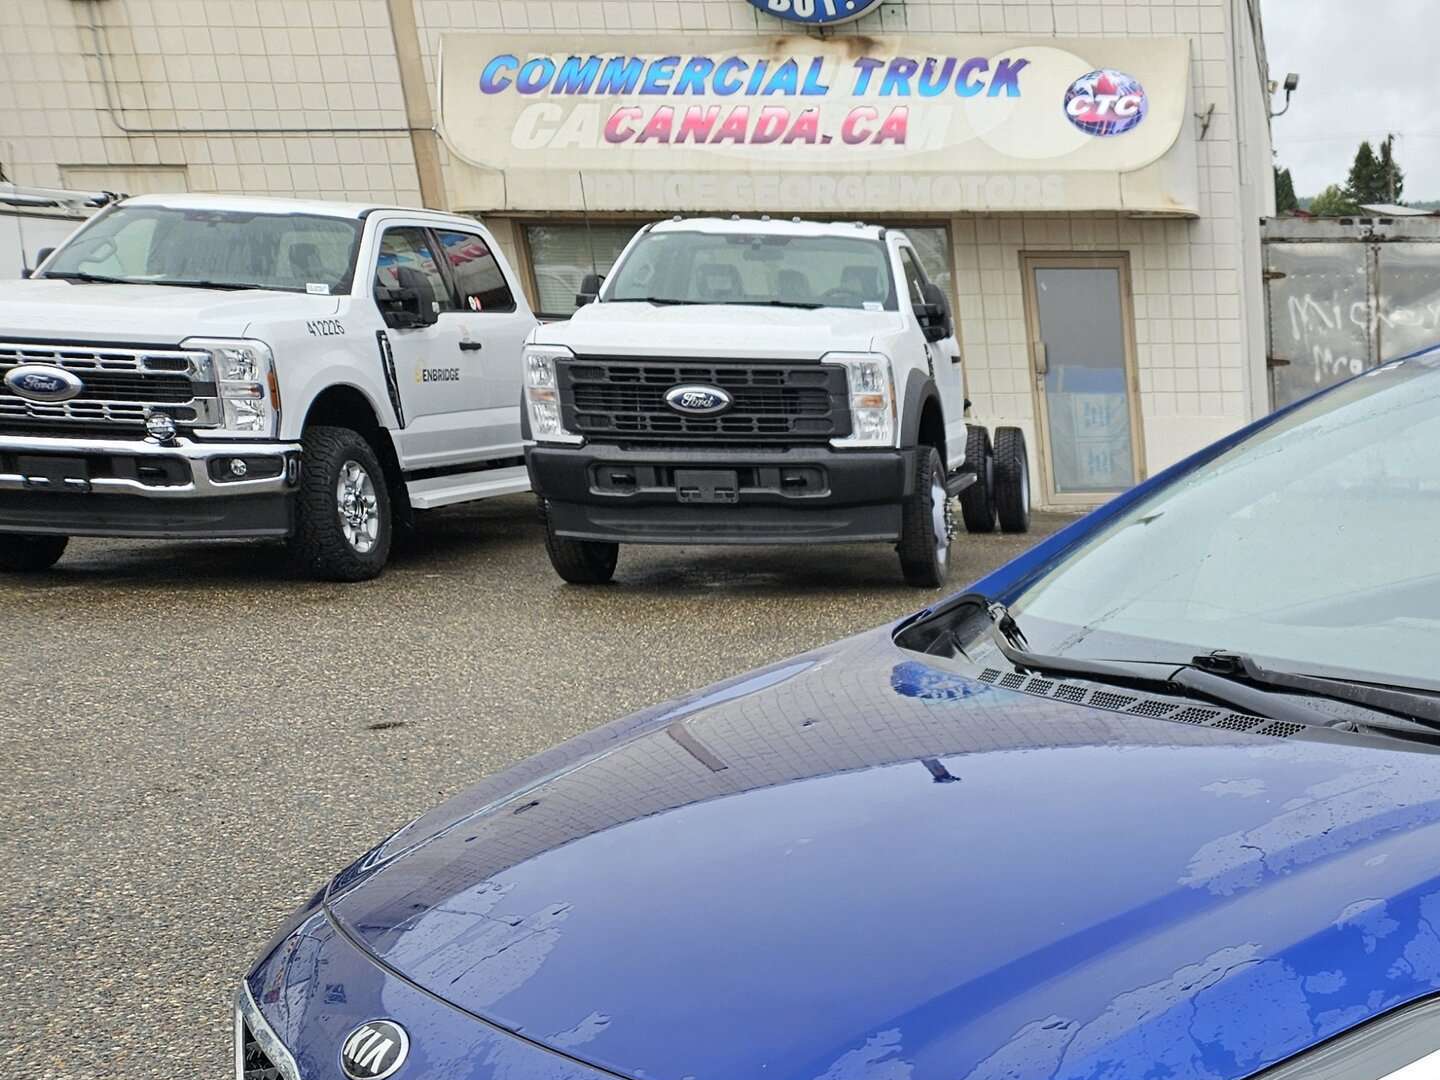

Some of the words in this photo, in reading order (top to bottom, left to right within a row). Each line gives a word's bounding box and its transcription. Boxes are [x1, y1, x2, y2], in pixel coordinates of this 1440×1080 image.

[479, 54, 830, 96] COMMERCIAL
[852, 56, 1031, 98] TRUCK
[1066, 94, 1142, 117] CTC
[603, 104, 910, 146] CANADA.CA
[570, 174, 718, 209] PRINCE
[732, 174, 898, 209] GEORGE
[904, 174, 1065, 209] MOTORS
[306, 320, 346, 337] 412226
[24, 374, 57, 392] Ford
[422, 368, 461, 383] ENBRIDGE
[681, 392, 714, 408] Ford
[344, 1025, 394, 1074] KIA
